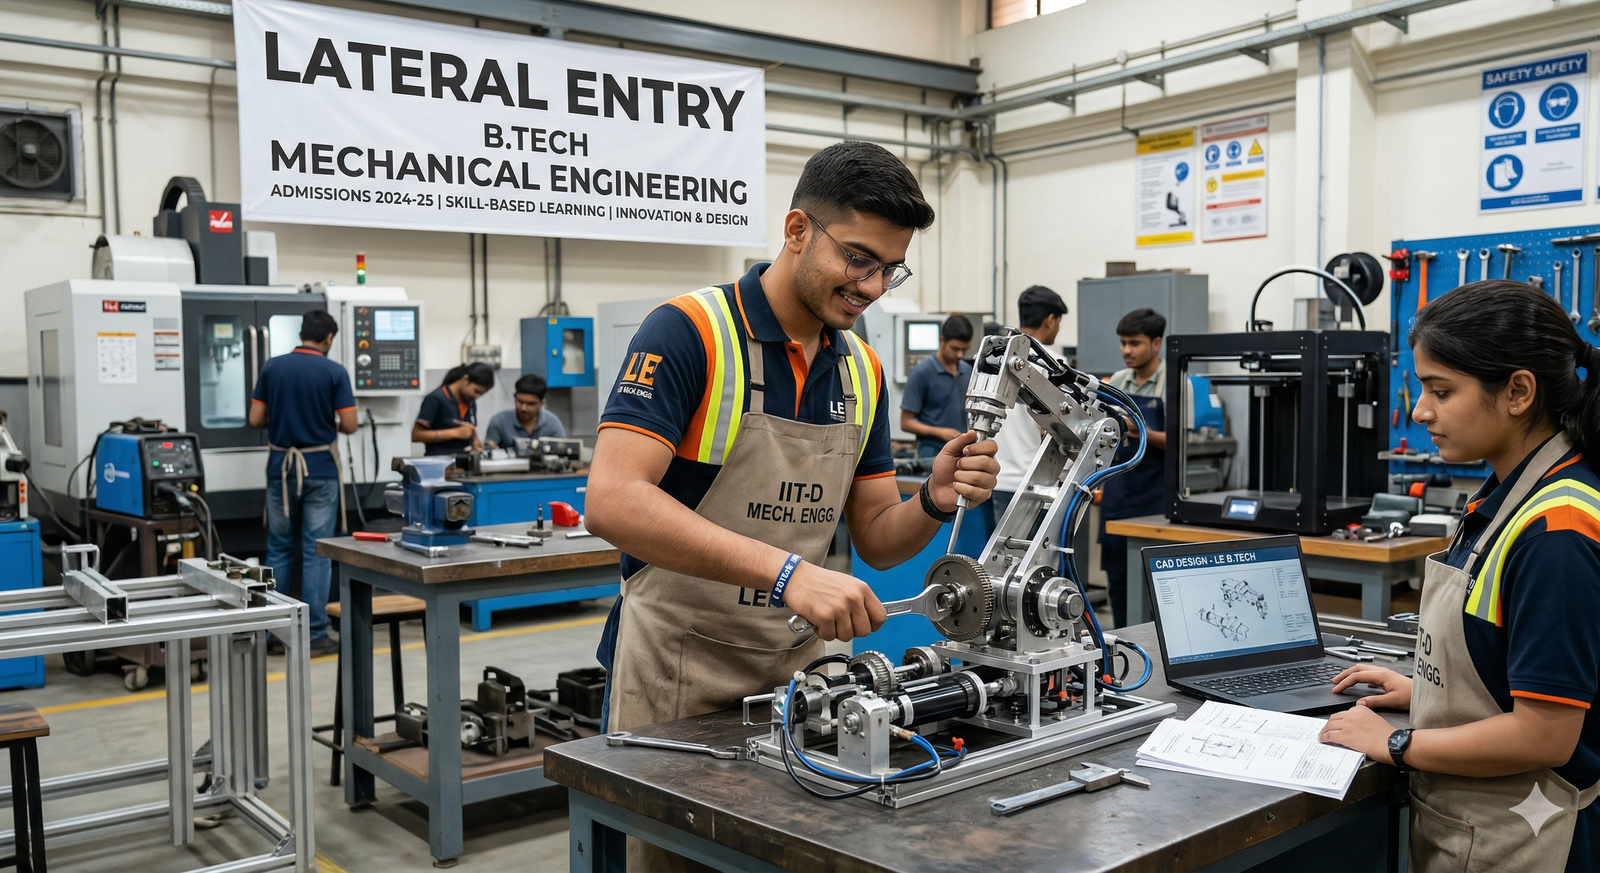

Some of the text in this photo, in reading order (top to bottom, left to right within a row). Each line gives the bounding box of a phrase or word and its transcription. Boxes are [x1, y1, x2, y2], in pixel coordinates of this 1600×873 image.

[265, 31, 745, 132] LATERAL ENTRY
[1485, 58, 1583, 85] SAFETY SAFETY
[484, 123, 588, 157] B.TECH
[271, 140, 747, 206] MECHANICAL ENGINEERING
[270, 184, 371, 203] ADMISSIONS
[375, 191, 434, 207] 2024-25
[446, 195, 536, 213] SKILL-BASED
[540, 202, 605, 217] LEARNING
[616, 207, 692, 223] INNOVATION
[695, 212, 703, 223] &
[706, 213, 748, 226] DESIGN
[622, 352, 663, 386] LE
[830, 400, 845, 415] LE
[778, 481, 823, 503] IIT-D
[747, 502, 835, 523] MECH. ENGG.
[1155, 559, 1174, 569] CAD
[1176, 557, 1208, 567] DESIGN
[1214, 555, 1225, 564] LE
[1226, 552, 1256, 563] B.TECH
[1416, 657, 1444, 688] ENGG.
